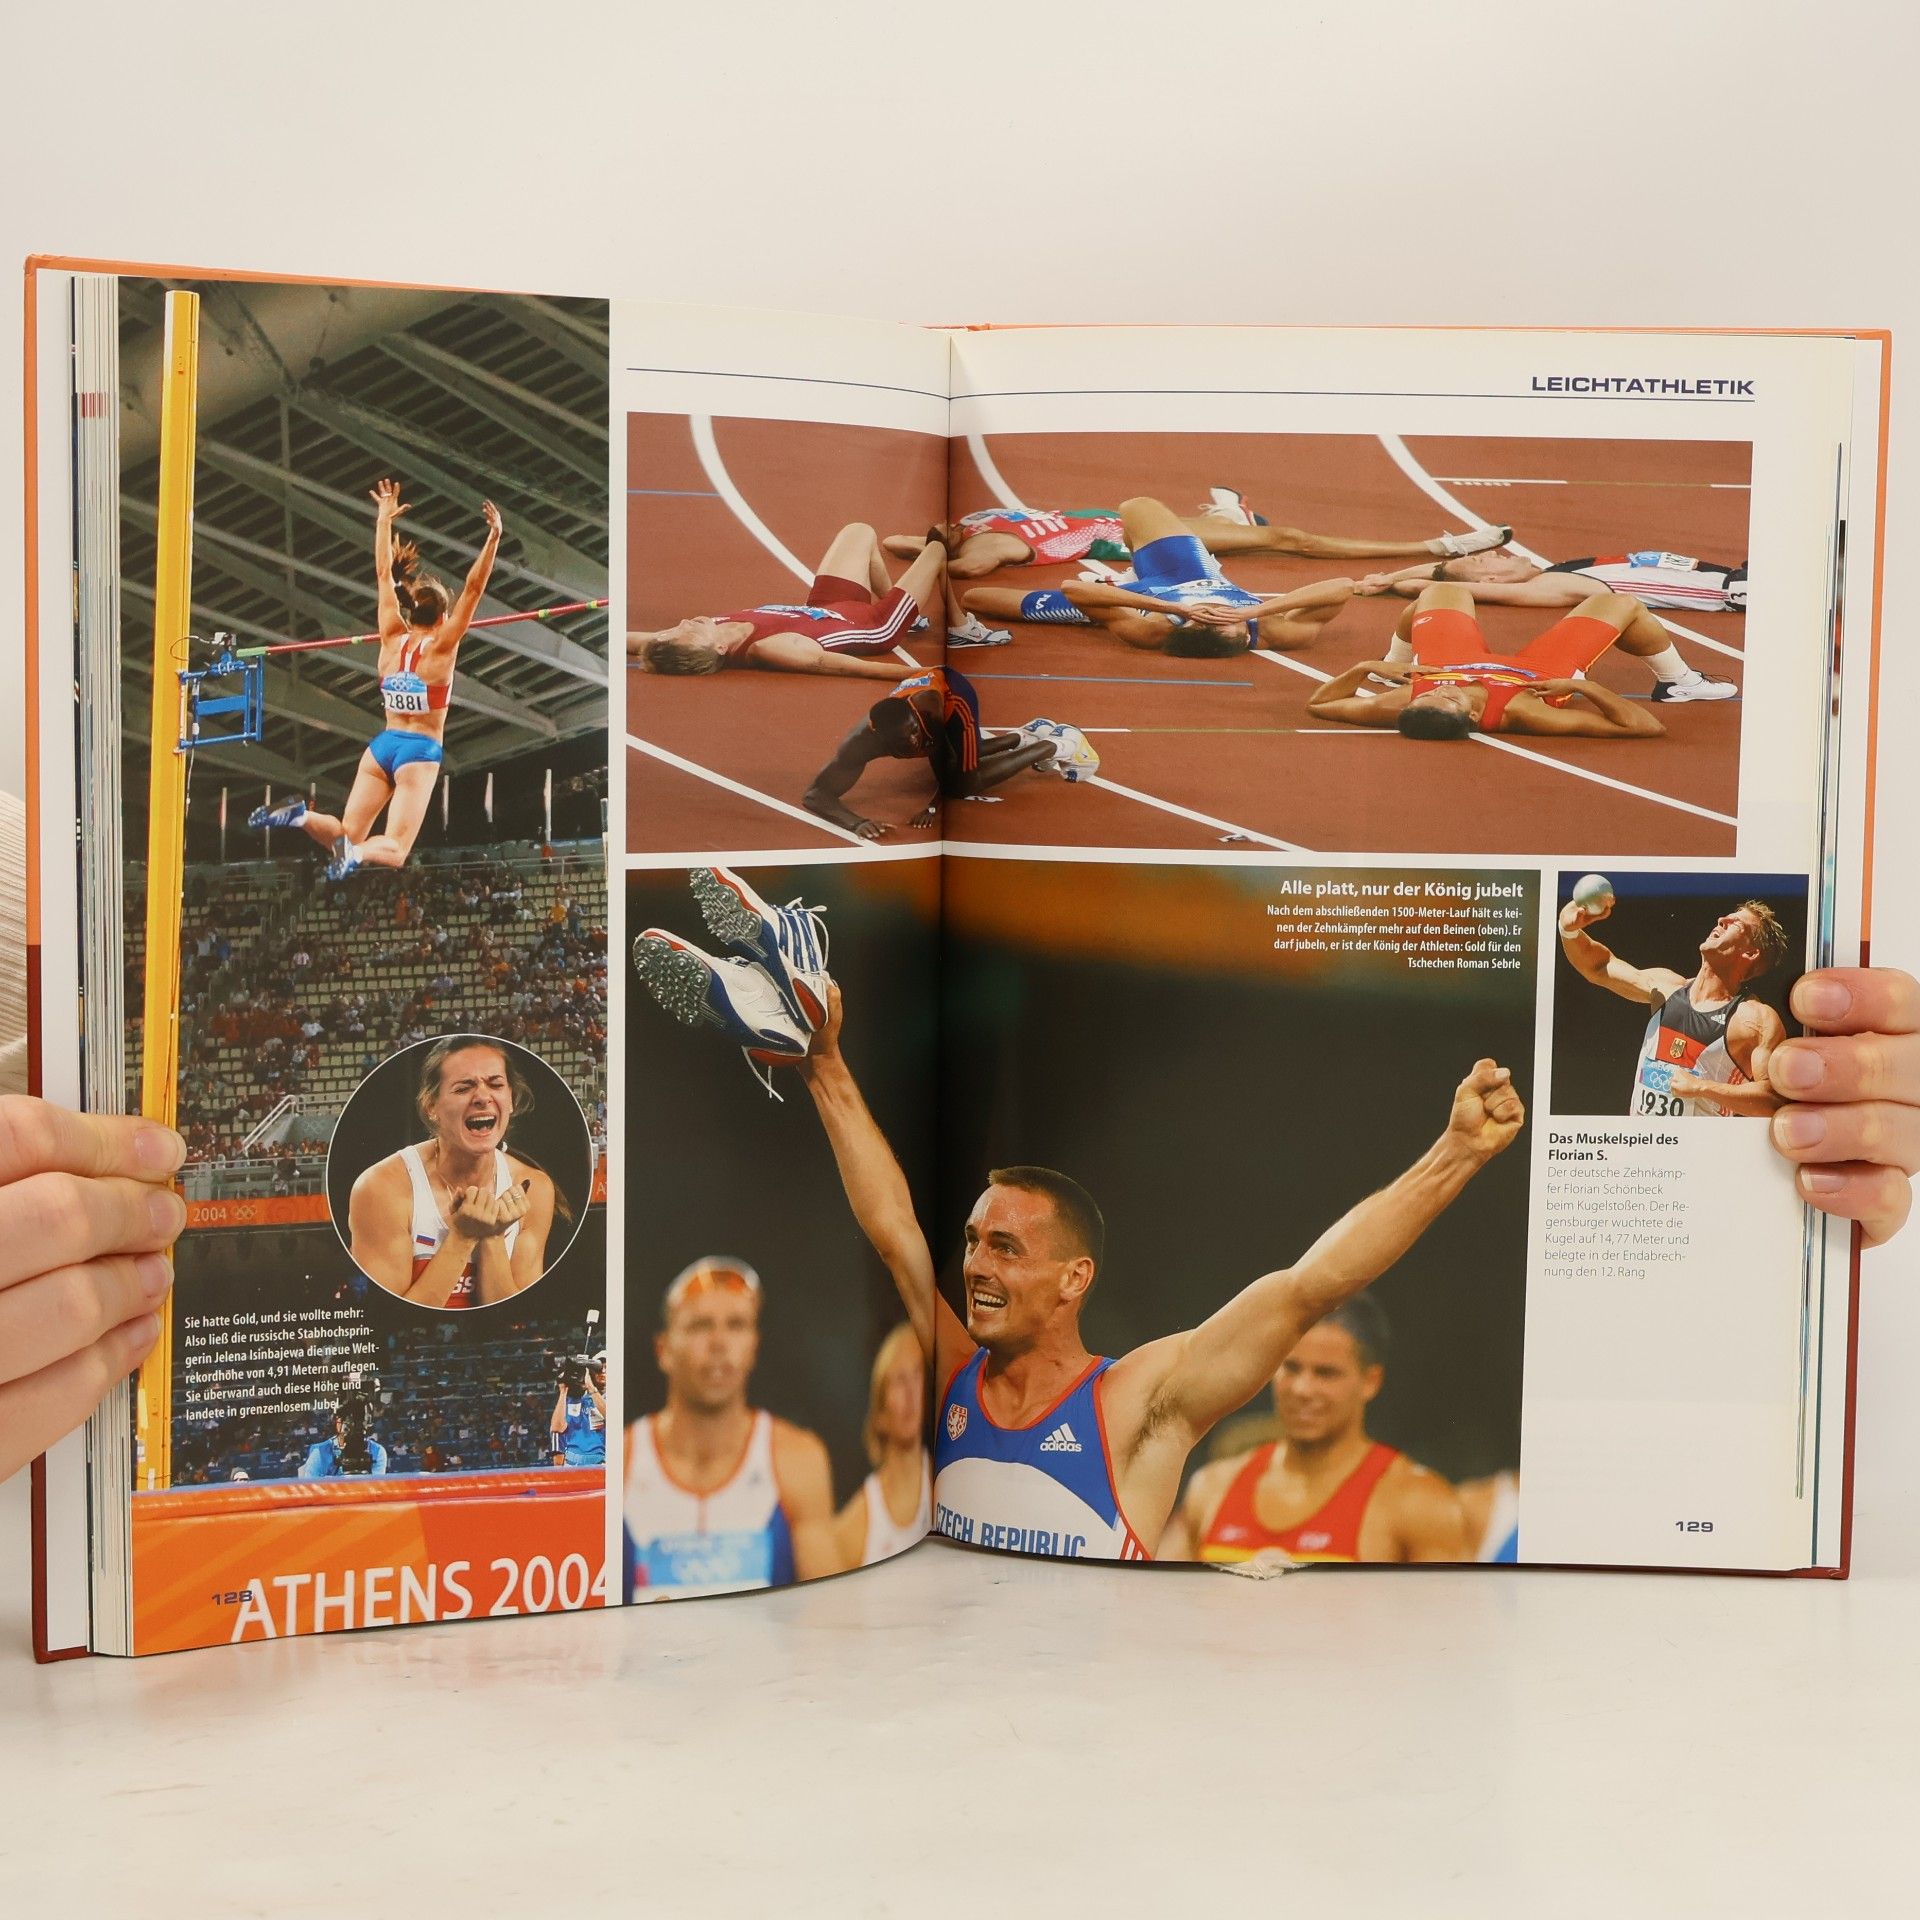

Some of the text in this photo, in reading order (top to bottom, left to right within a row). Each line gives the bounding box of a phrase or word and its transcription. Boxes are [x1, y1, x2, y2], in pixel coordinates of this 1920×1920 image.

[1532, 377, 1754, 395] LEICHTATHLETIK
[387, 693, 422, 710] 2881
[1281, 880, 1523, 900] Alle platt, nur der König jubelt
[1267, 905, 1522, 919] Nach dem abschließenden 1500-Meter-Lauf hält es kei-
[1277, 922, 1521, 937] nen der Zehnkämpfer mehr auf den Beinen (oben). Er
[1274, 939, 1521, 953] darf jubeln, er ist der König der Athleten: Gold für den
[1408, 957, 1520, 969] Tschechen Roman Sebrle
[1641, 1090, 1684, 1116] 1930
[1549, 1133, 1678, 1147] Das Muskelspiel des
[1549, 1149, 1607, 1160] Florian S.
[1548, 1167, 1685, 1179] Der deutsche Zehnkämp-
[1547, 1183, 1663, 1194] fer Florian Schönbeck
[1547, 1200, 1689, 1213] beim Kugelstoßen. Der Re-
[193, 1207, 227, 1222] 2004
[1546, 1217, 1683, 1229] gensburger wuchtete die
[1545, 1233, 1575, 1245] Kugel
[1579, 1234, 1596, 1244] auf
[1633, 1234, 1664, 1244] Meter
[1668, 1235, 1689, 1244] und
[1545, 1250, 1685, 1262] belegte in der Endabrech-
[1545, 1267, 1645, 1279] nung den 12. Rang
[185, 1307, 364, 1328] Sie hatte Gold, und sie wollte mehr:
[185, 1325, 373, 1347] Also ließ die russische Stabhochsprin-
[186, 1342, 379, 1368] gerin Jelena Isinbajewa die neue Welt-
[186, 1361, 379, 1384] rekordhöhe von 4,91 Metern auflegen.
[186, 1378, 360, 1402] Sie überwand auch diese Höhe und
[186, 1409, 224, 1421] landete
[228, 1406, 236, 1417] in
[240, 1400, 310, 1420] grenzenlosem
[1040, 1441, 1082, 1451] adidas
[1676, 1521, 1713, 1532] 129
[212, 1590, 252, 1606] 128
[230, 1561, 473, 1643] ATHENS
